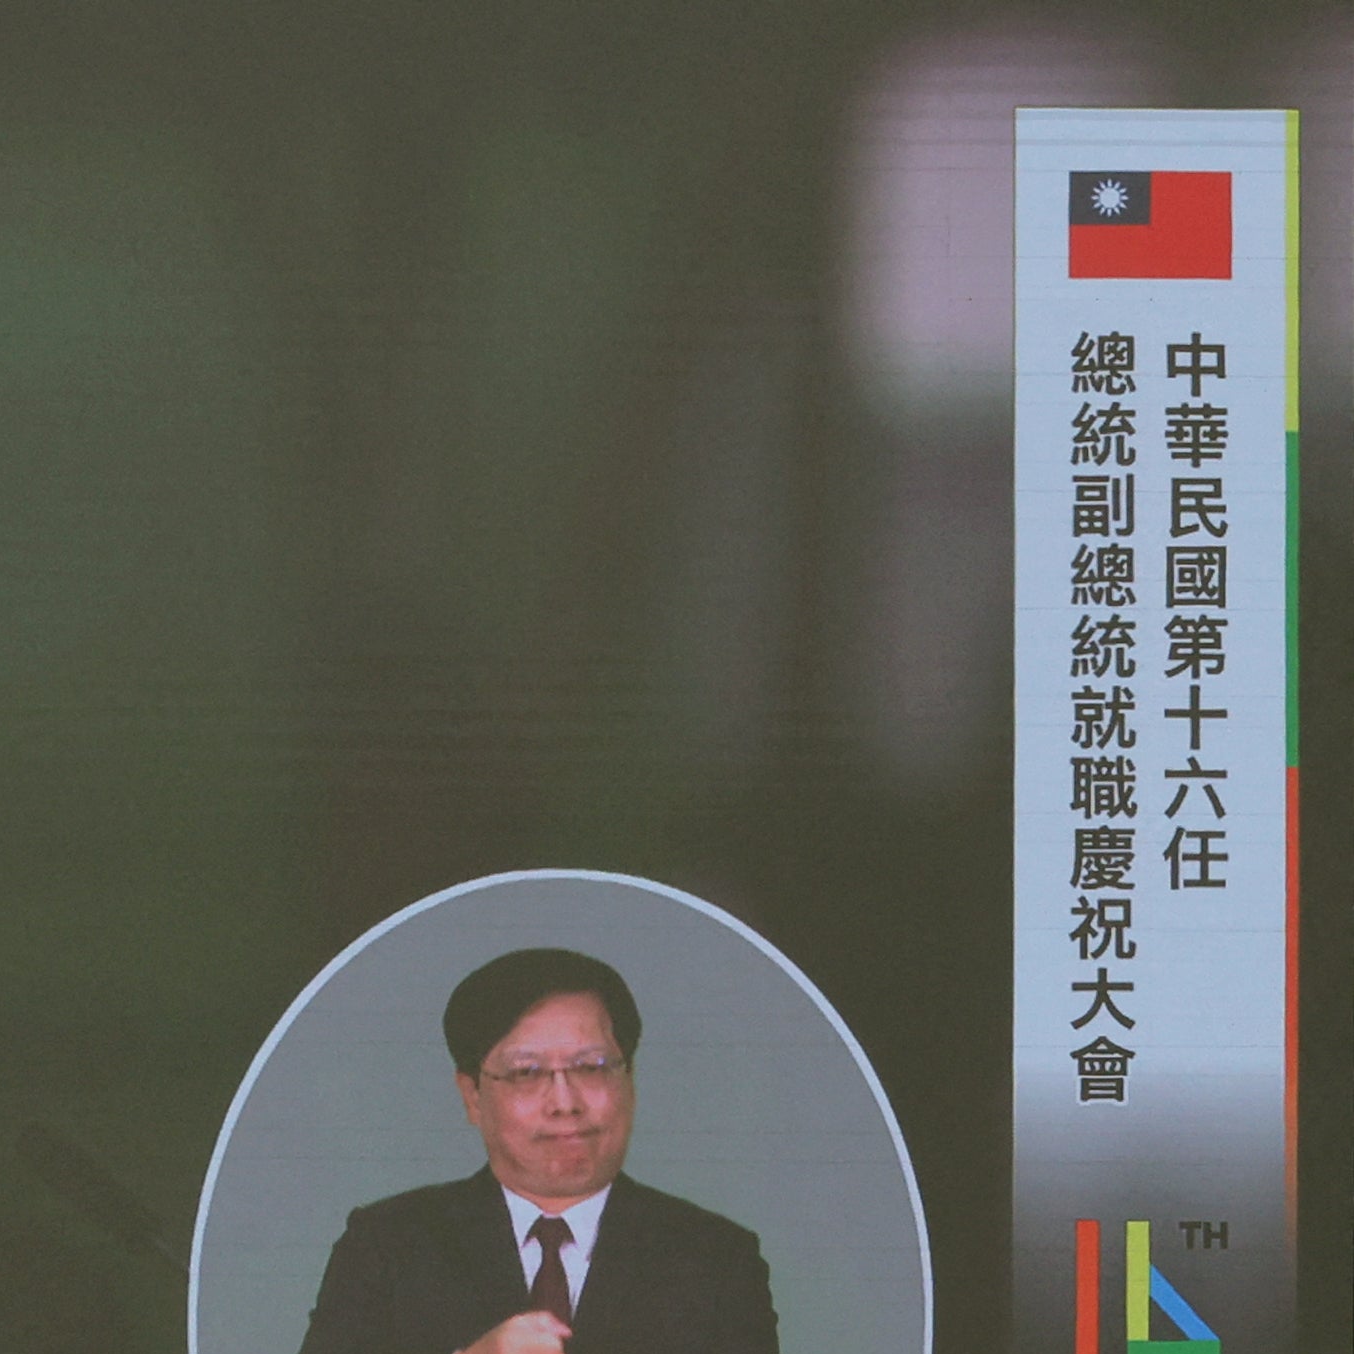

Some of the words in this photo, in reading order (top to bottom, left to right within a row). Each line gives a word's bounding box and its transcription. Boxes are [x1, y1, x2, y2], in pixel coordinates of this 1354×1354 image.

[1071, 331, 1137, 1102] 總統副總統就職慶祝大會
[1164, 332, 1229, 890] 中華民國第十六任
